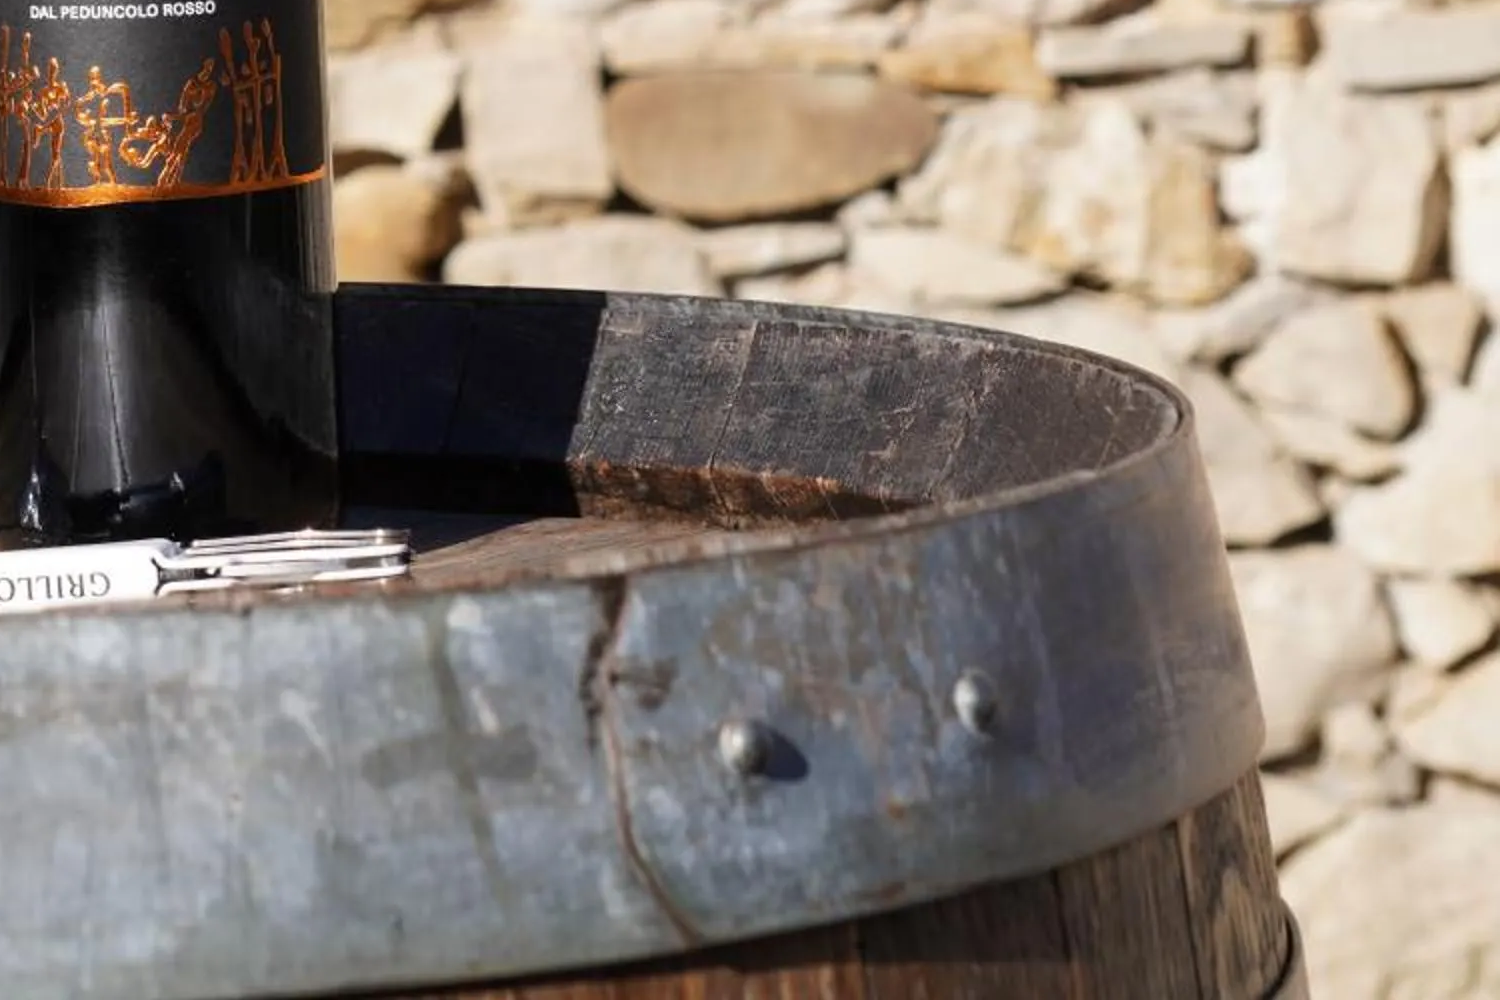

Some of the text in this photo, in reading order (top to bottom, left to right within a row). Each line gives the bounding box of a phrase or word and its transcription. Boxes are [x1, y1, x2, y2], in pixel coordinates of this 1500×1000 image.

[29, 1, 217, 20] DAL PEDUNCOLO ROSSO
